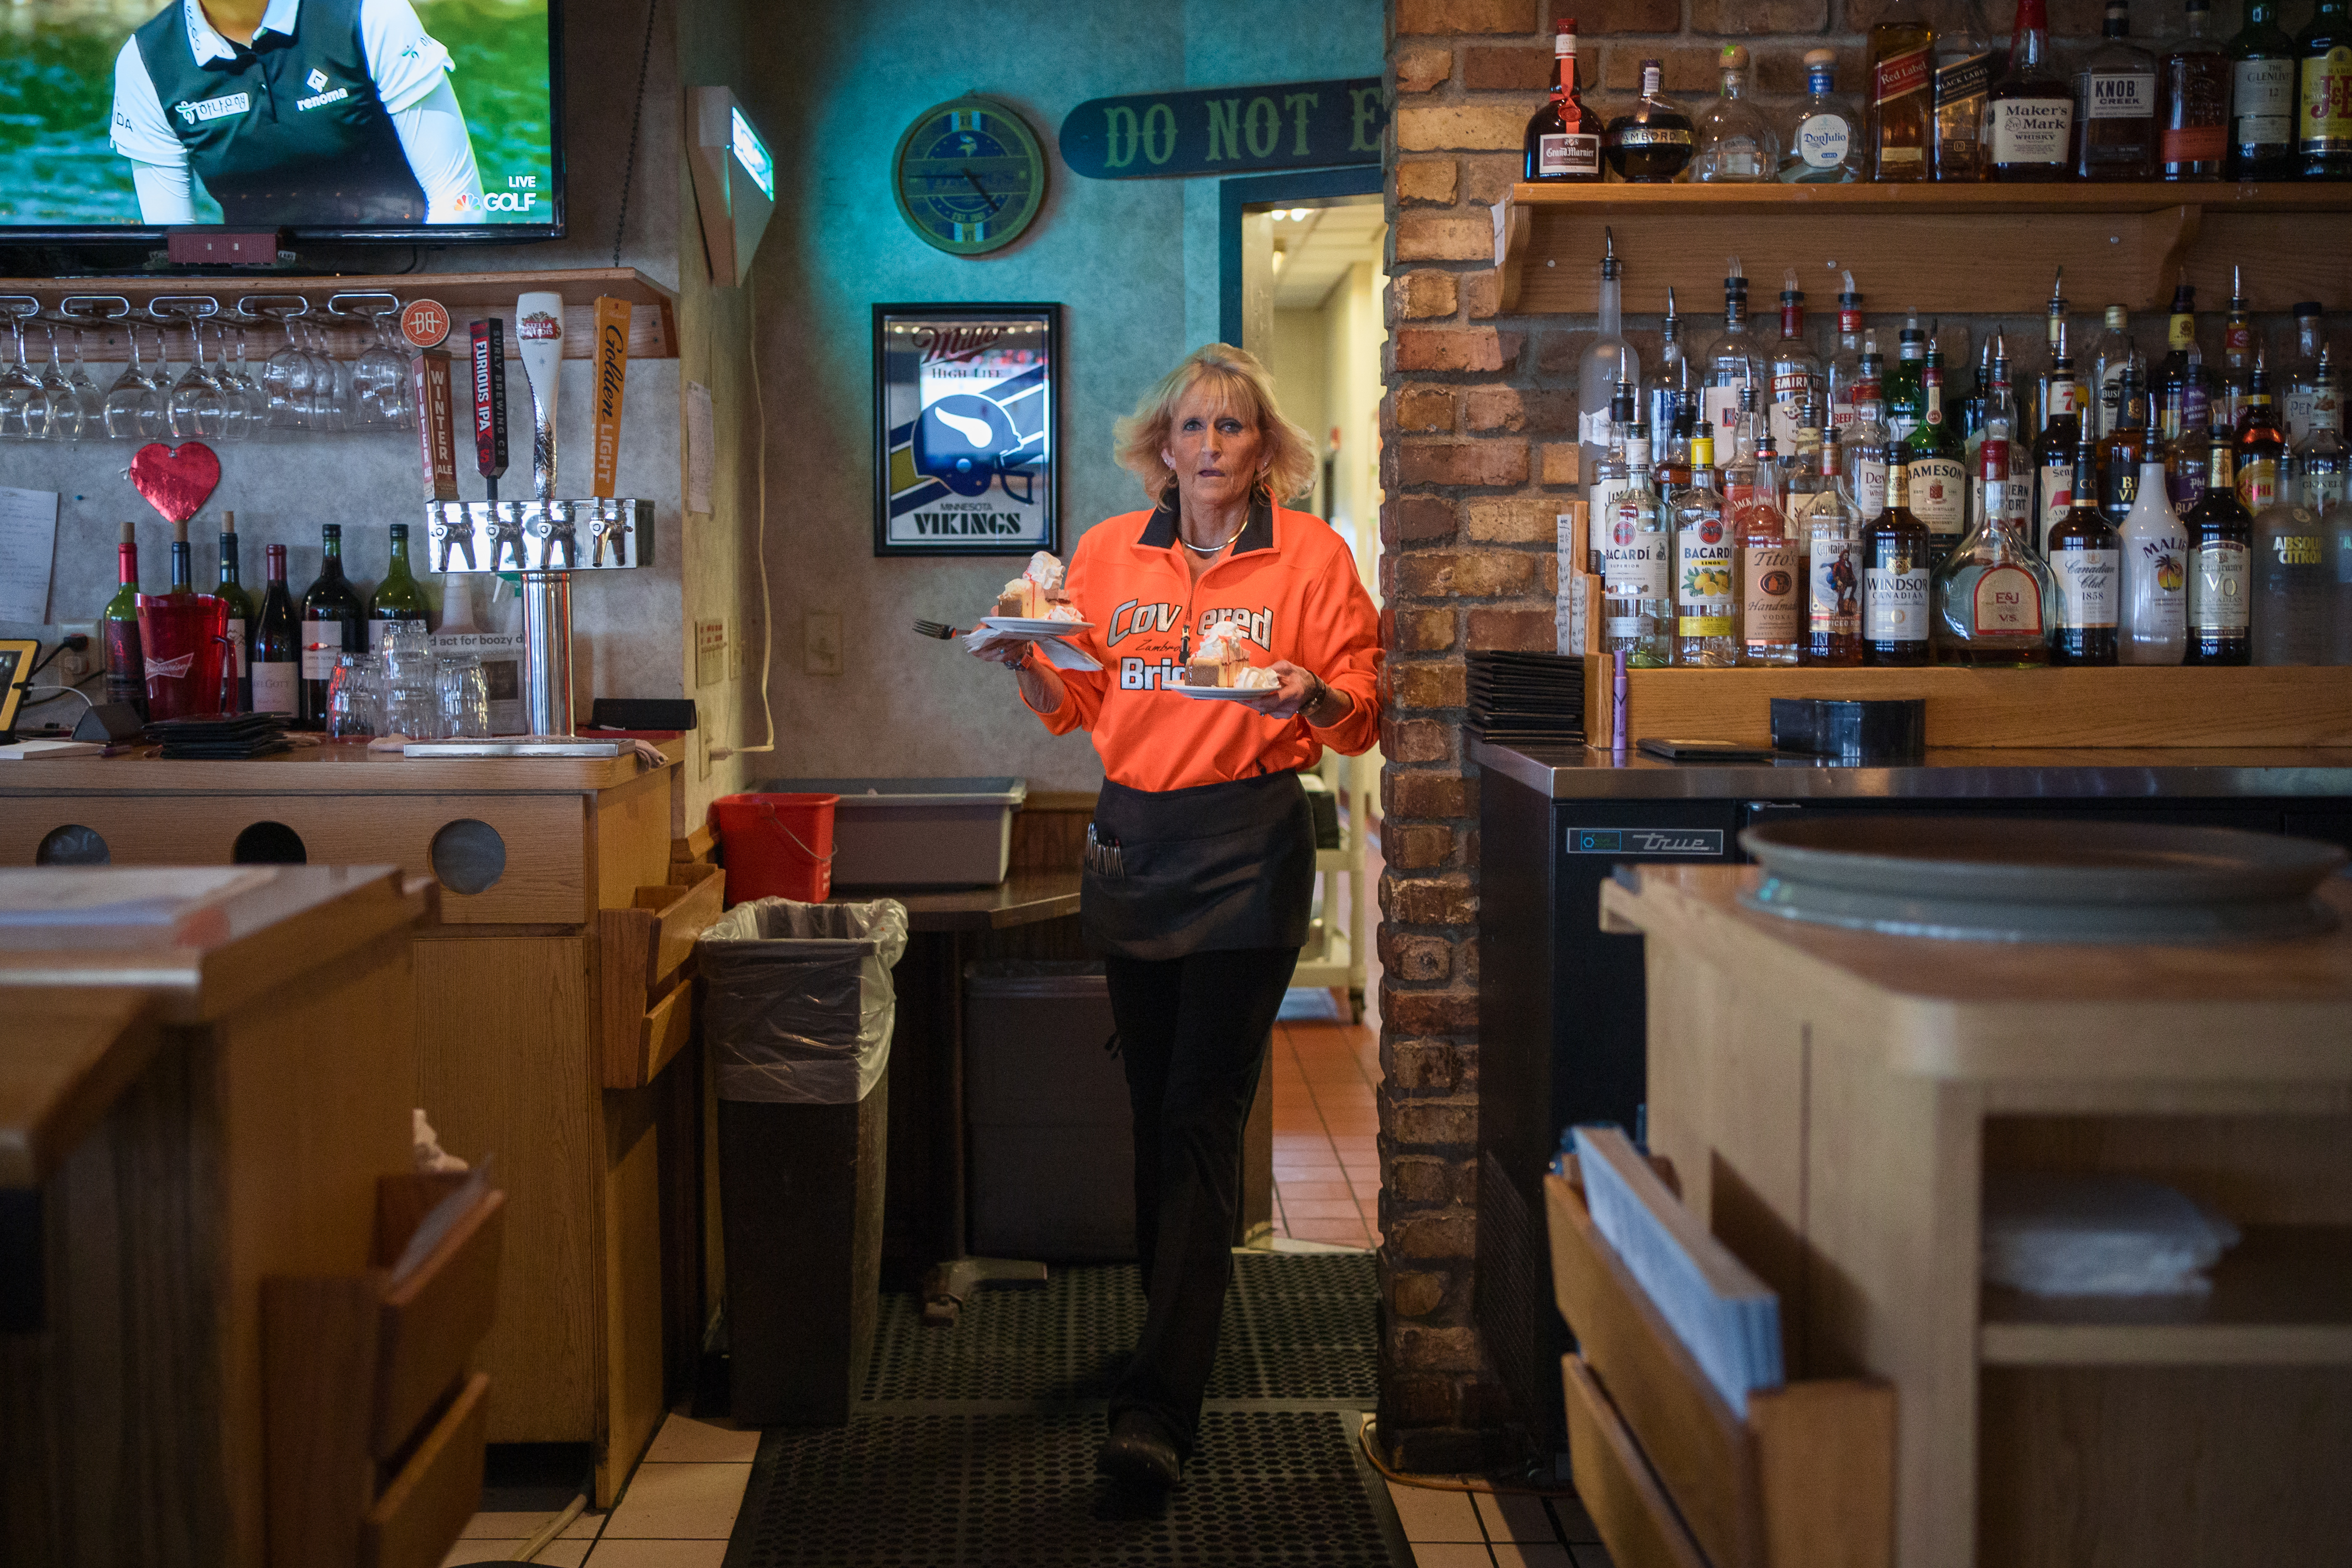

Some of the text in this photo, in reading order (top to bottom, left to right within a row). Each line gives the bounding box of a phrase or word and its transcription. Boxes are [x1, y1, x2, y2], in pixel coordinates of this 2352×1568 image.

[1881, 72, 1900, 85] Red
[1901, 61, 1927, 77] Label
[1936, 78, 1962, 92] BLACK
[1963, 68, 1988, 82] LABEL
[2096, 80, 2135, 97] KNOB
[296, 88, 349, 112] renoma
[2006, 106, 2067, 115] Maker's
[1103, 103, 1179, 168] DO
[1206, 91, 1319, 162] NOT
[2023, 119, 2066, 129] Mark
[1546, 147, 1595, 157] Grand Marnier
[508, 176, 535, 188] LIVE
[483, 192, 536, 212] GOLF
[493, 330, 502, 370] SURLY
[476, 340, 489, 403] FURIOUS
[602, 324, 624, 422] Golden
[932, 368, 1003, 378] HIGH LIFE
[495, 374, 505, 434] BREWING
[2063, 391, 2074, 411] 7
[416, 372, 429, 463] WINTER
[430, 370, 448, 461] WINTER
[478, 406, 491, 432] IPA
[598, 423, 613, 483] LIGHT
[437, 464, 453, 475] ALE
[1908, 464, 1962, 481] JAMESON
[940, 502, 993, 511] MINNESOTA
[1733, 497, 1752, 512] JACK
[914, 513, 1021, 535] VIKINGS
[1606, 546, 1651, 560] BACARDÍ
[1817, 543, 1845, 556] Captain
[1755, 551, 1795, 566] Tito's
[2065, 559, 2115, 574] Canadian
[1867, 578, 1928, 591] WINDSOR
[2078, 574, 2107, 589] Club
[1995, 592, 2019, 604] E&J
[2082, 591, 2104, 601] 1858
[440, 637, 458, 646] act
[460, 636, 477, 645] for
[479, 635, 512, 646] boozy
[146, 661, 192, 674] Budweiser
[1633, 833, 1710, 851] true
